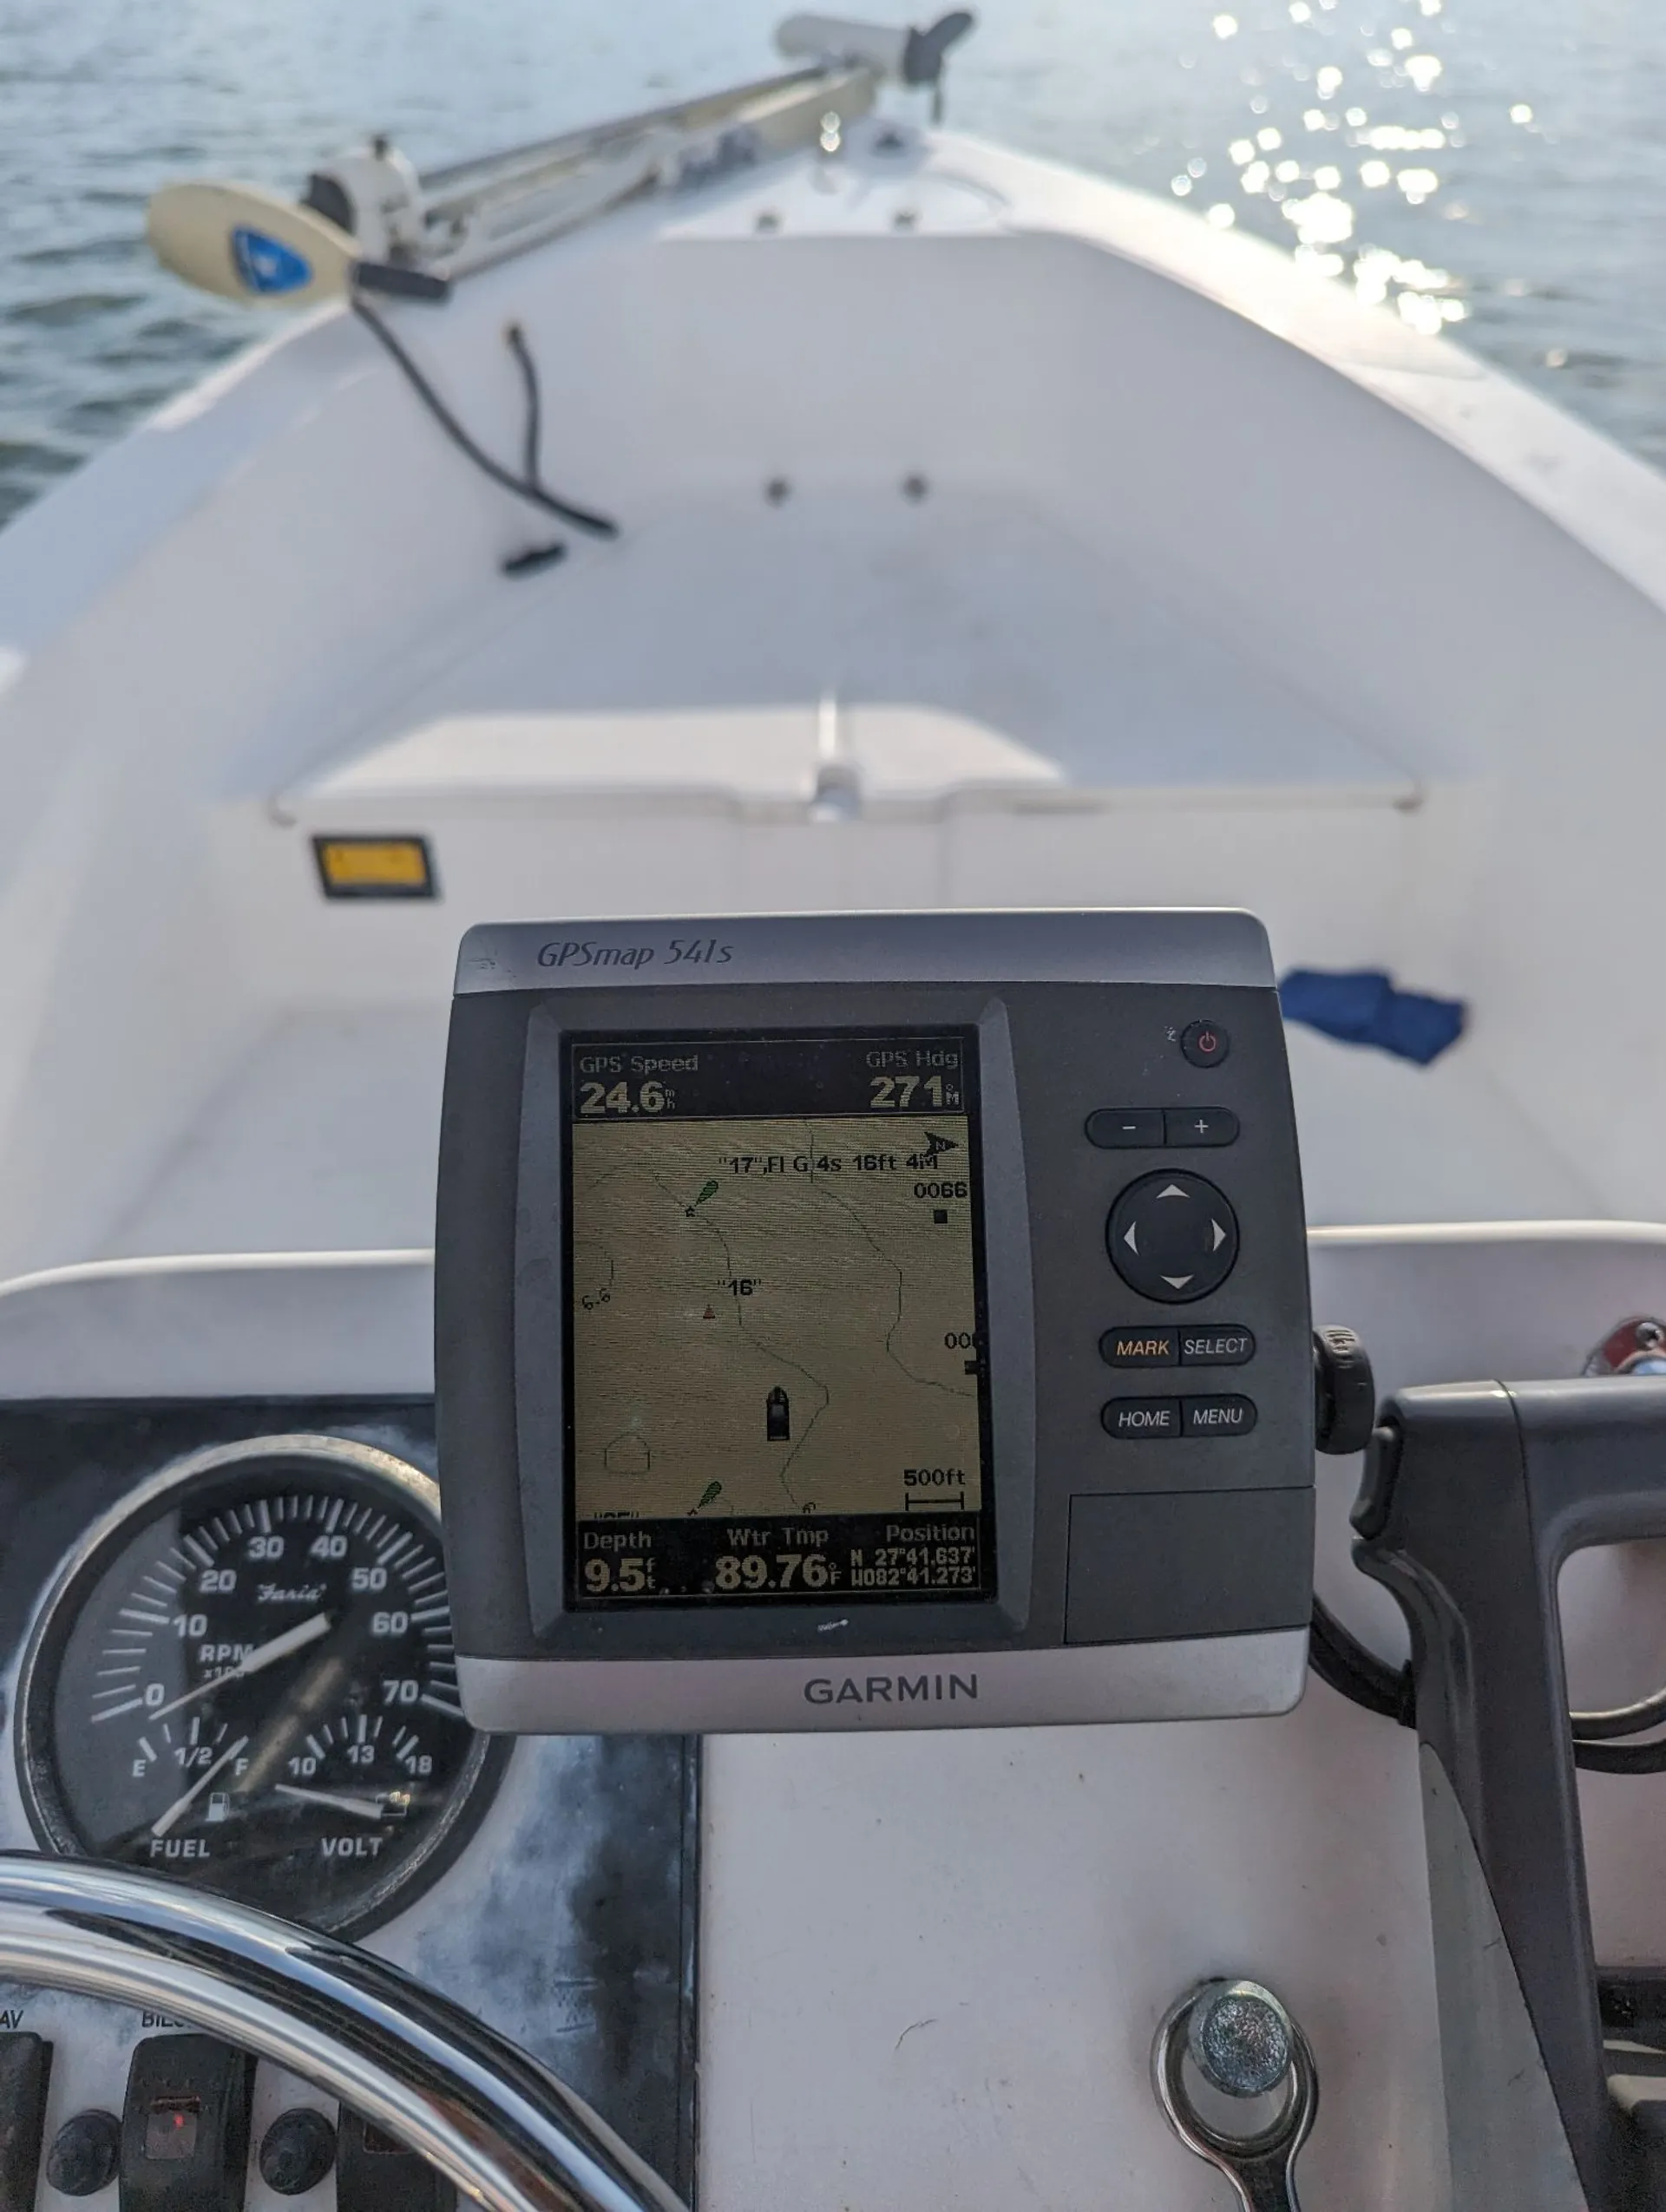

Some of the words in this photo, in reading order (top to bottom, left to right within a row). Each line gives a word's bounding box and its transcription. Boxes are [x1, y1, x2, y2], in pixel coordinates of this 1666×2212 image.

[537, 941, 654, 970] GPSmap
[580, 1056, 621, 1074] GPS
[631, 1055, 699, 1075] Speed
[866, 1050, 908, 1068] GPS
[916, 1050, 959, 1070] Hdg
[580, 1080, 666, 1115] 24.6
[869, 1075, 942, 1109] 271
[914, 1181, 968, 1199] 0066
[1116, 1340, 1171, 1357] MARK
[1184, 1337, 1249, 1355] SELECT
[1118, 1410, 1171, 1427] HOME
[1192, 1407, 1244, 1424] MENU
[902, 1468, 967, 1487] 500ft
[583, 1531, 652, 1552] Depth
[726, 1528, 771, 1547] Wtr
[781, 1526, 830, 1547] Tmp
[886, 1523, 976, 1542] Position
[249, 1538, 285, 1558] 30
[311, 1537, 348, 1557] 40
[200, 1570, 237, 1593] 20
[352, 1568, 388, 1590] 50
[584, 1558, 646, 1593] 9.5
[715, 1554, 827, 1590] 89.76
[174, 1613, 208, 1638] 10
[371, 1613, 409, 1634] 60
[145, 1684, 166, 1706] 0
[384, 1680, 419, 1704] 70
[803, 1673, 979, 1705] GARMIN
[174, 1747, 213, 1768] 1/2
[347, 1744, 376, 1764] 13
[133, 1759, 147, 1777] E
[234, 1758, 250, 1777] F
[289, 1757, 318, 1776] 10
[405, 1755, 433, 1774] 18
[149, 1839, 211, 1859] FUEL
[321, 1837, 384, 1857] VOLT
